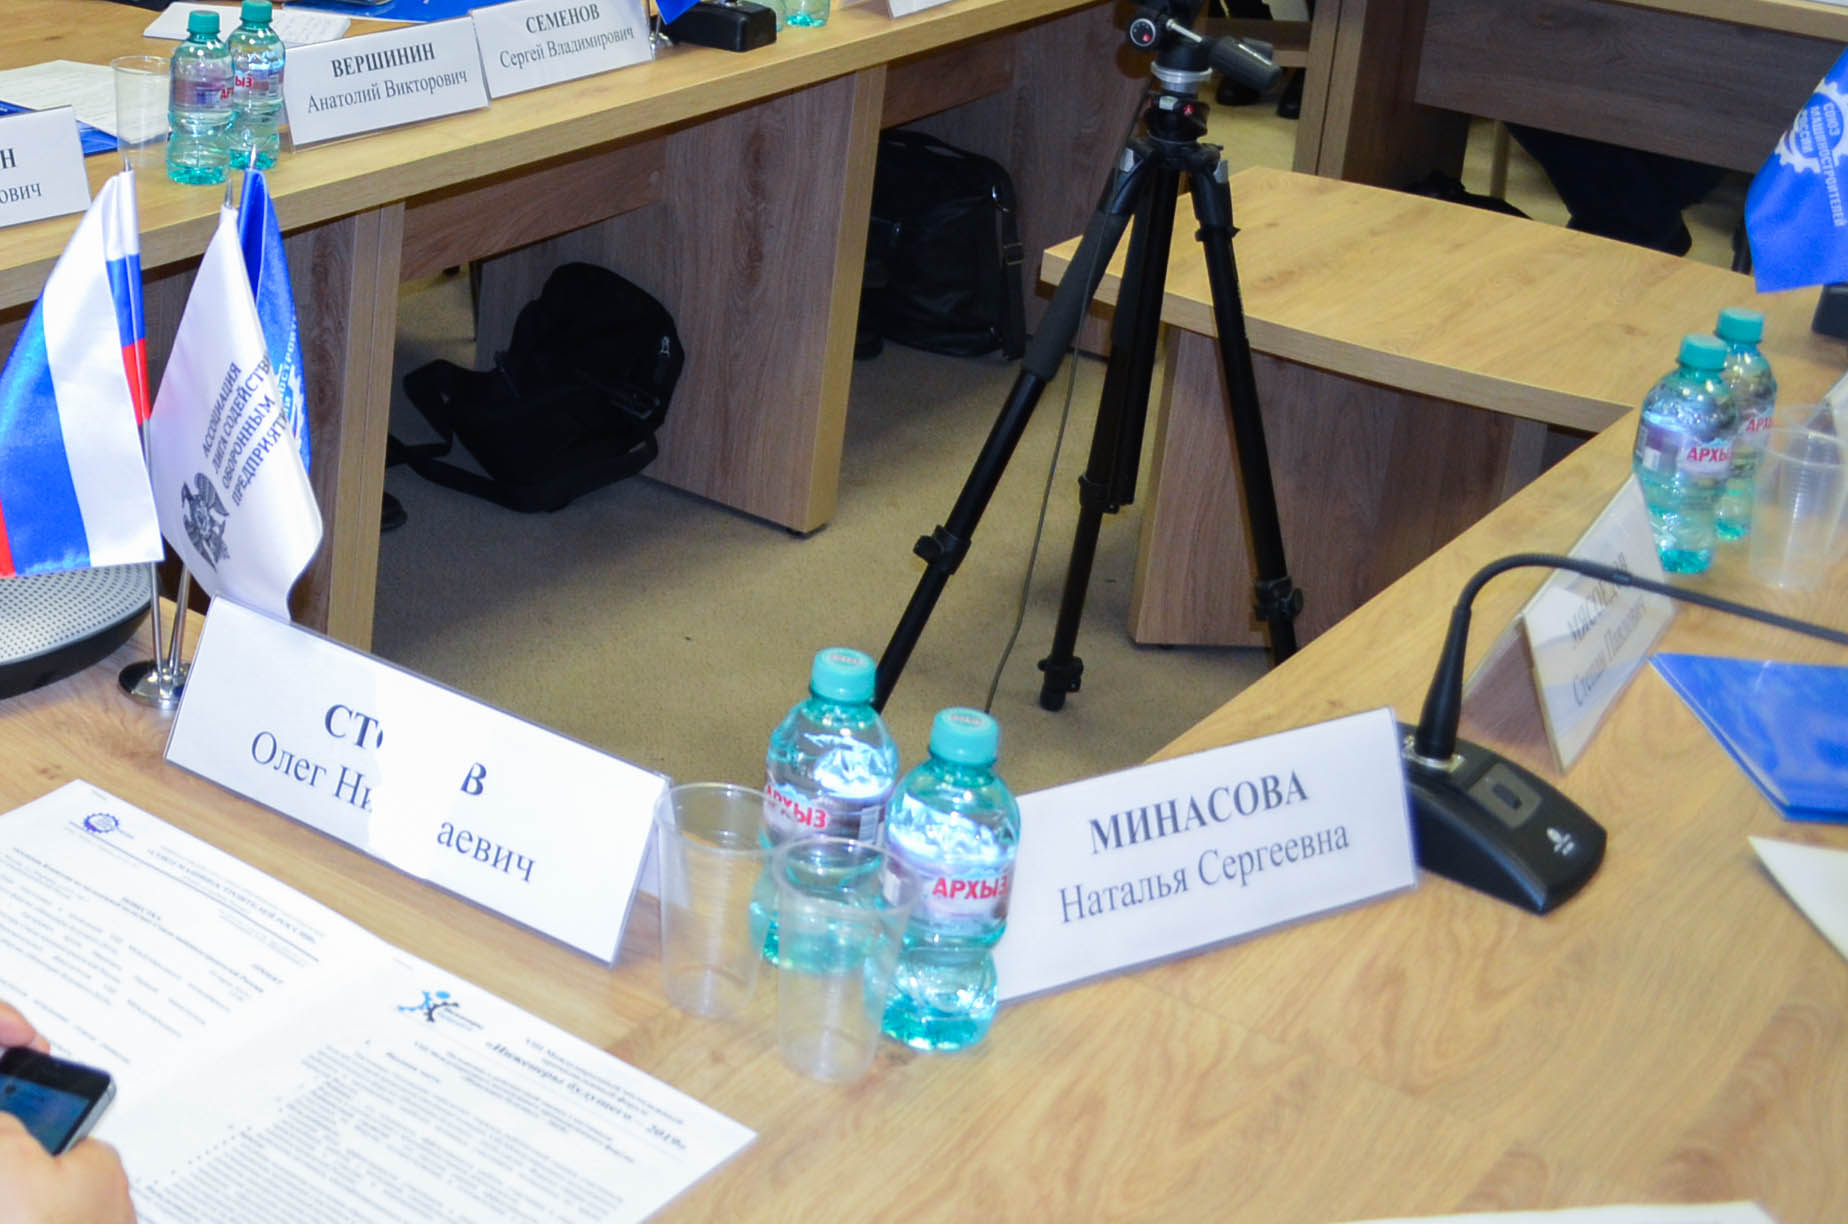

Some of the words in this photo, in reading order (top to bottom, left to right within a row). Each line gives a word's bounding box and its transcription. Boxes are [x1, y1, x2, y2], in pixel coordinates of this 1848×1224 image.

[525, 2, 601, 35] СЕМЕНОВ
[330, 41, 437, 79] ВЕРШИНИН
[498, 41, 545, 71] Сергей
[547, 25, 635, 59] Владимирович
[306, 82, 383, 114] Анатолий
[384, 67, 469, 99] Викторович
[201, 361, 243, 461] АССОЦИАЦИЯ
[211, 432, 229, 475] ЛИГА
[220, 394, 277, 491] ОБОРОННЫМ
[250, 730, 328, 789] Олег
[1088, 767, 1310, 856] МИНАСОВА
[1059, 866, 1190, 925] Наталья
[1197, 822, 1351, 888] Сергеевна
